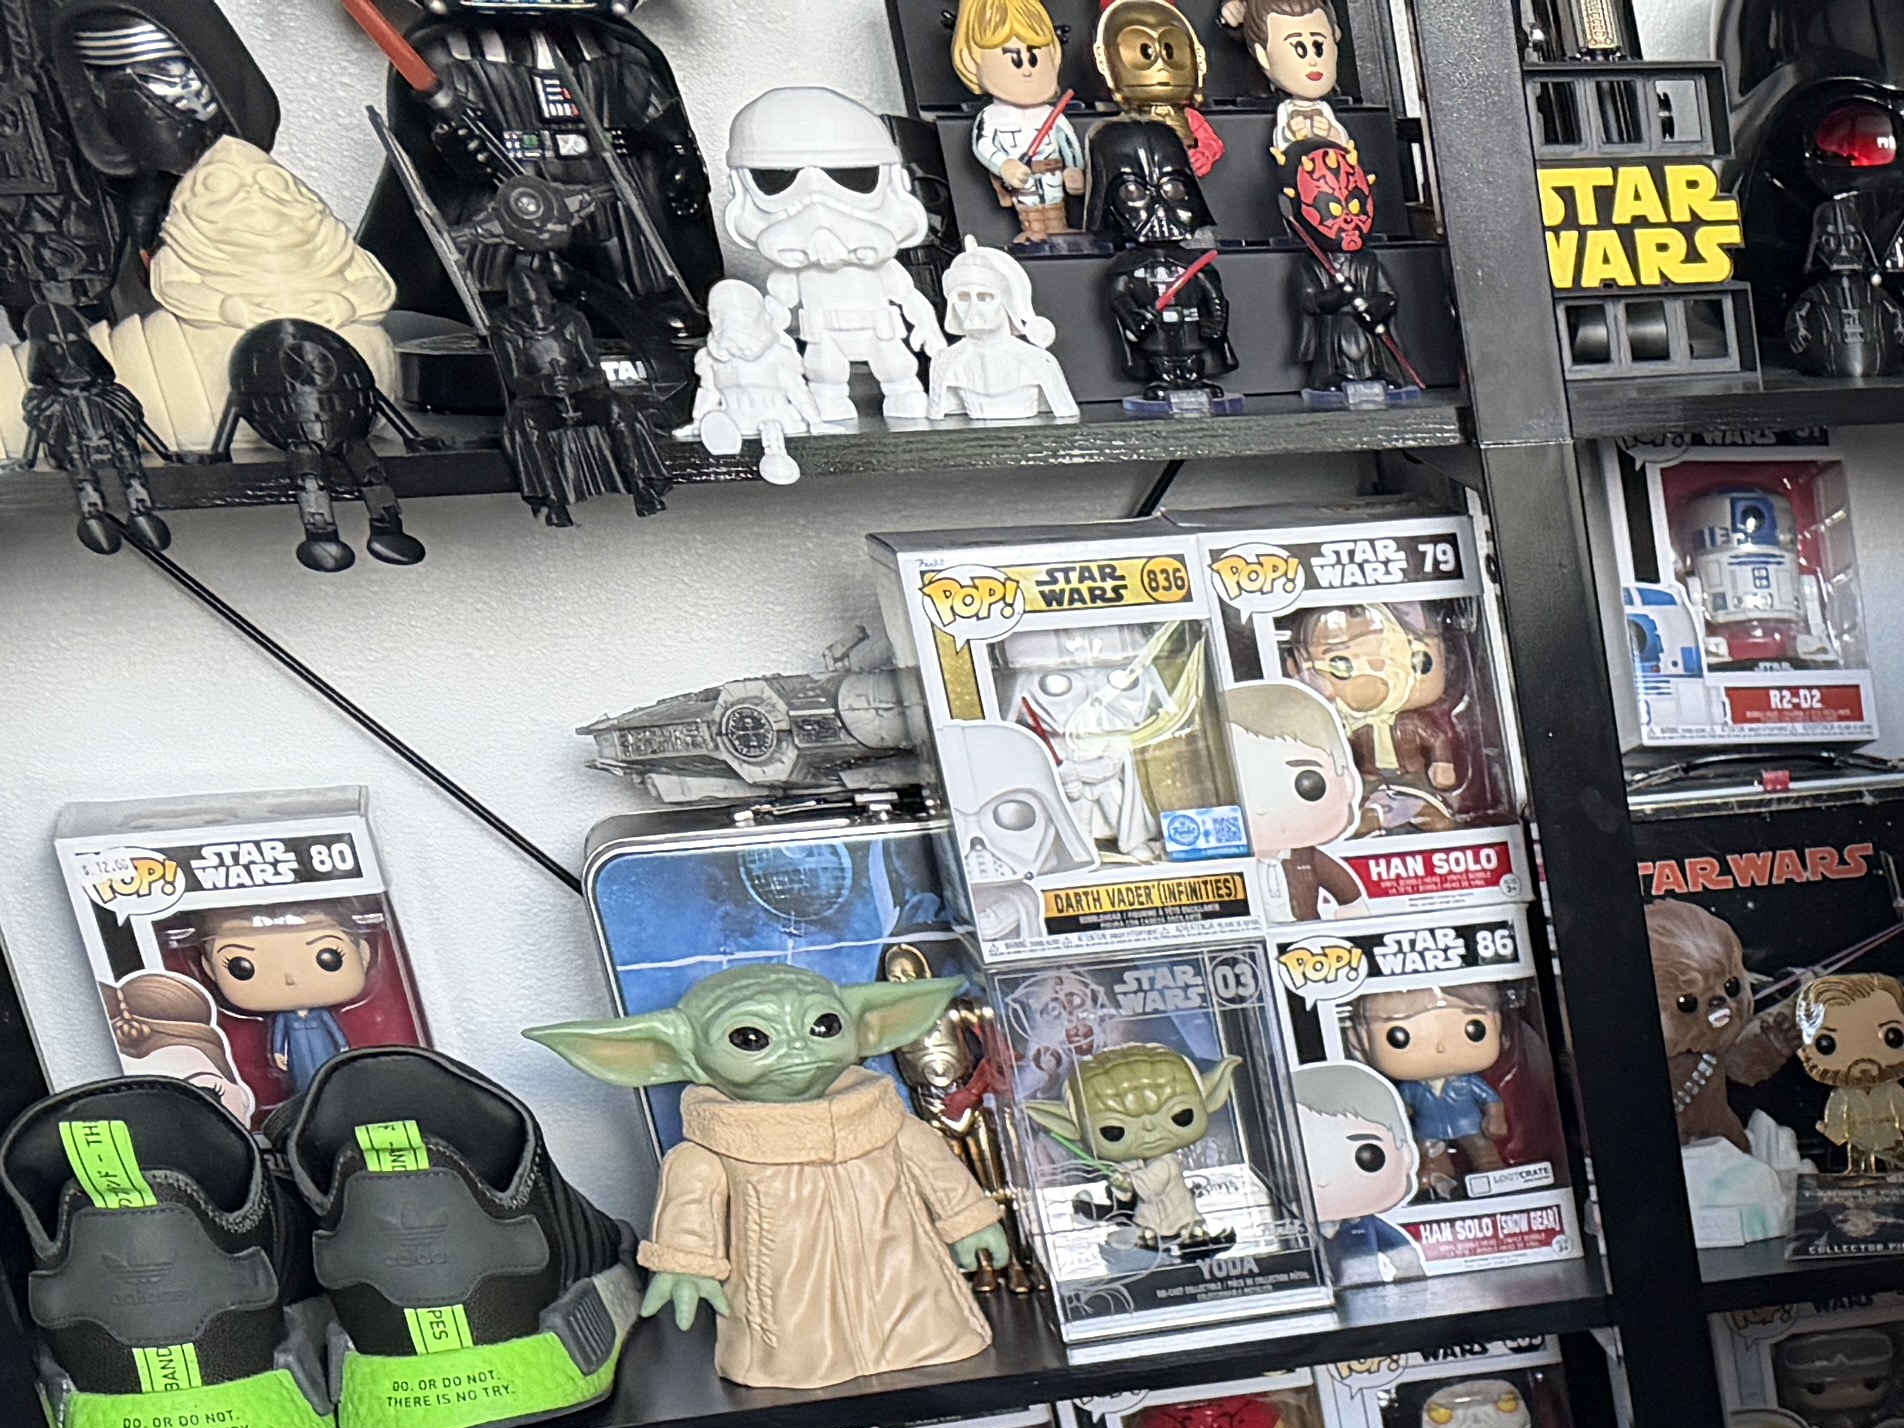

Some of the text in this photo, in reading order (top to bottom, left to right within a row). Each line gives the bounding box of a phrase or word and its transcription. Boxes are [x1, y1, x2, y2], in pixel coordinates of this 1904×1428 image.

[1310, 539, 1407, 567] STAR
[1418, 543, 1456, 573] 79
[1035, 564, 1127, 587] STAR
[1146, 567, 1186, 593] 836
[1210, 555, 1300, 600] POP!
[1312, 561, 1408, 588] WARS
[919, 576, 1020, 627] POP!
[1038, 583, 1128, 608] WARS
[1768, 689, 1823, 710] R2-D2
[190, 840, 297, 869] STAR
[309, 842, 355, 873] 80
[1369, 848, 1498, 881] HAN SOLO
[191, 861, 299, 890] WARS
[1637, 842, 1875, 896] TAR WARS
[1053, 892, 1101, 914] DARTH
[1157, 875, 1239, 907] (INFINITIES)
[1373, 928, 1467, 955] STAR
[1476, 928, 1515, 958] 86
[1279, 945, 1363, 990] POP!
[1375, 949, 1466, 976] WARS
[1113, 965, 1204, 993] STAR
[1214, 965, 1258, 999] 03
[1115, 986, 1208, 1016] WARS
[1419, 1222, 1453, 1245] HAN
[1455, 1217, 1493, 1240] SOLO
[1196, 1256, 1260, 1280] YODA
[392, 1380, 415, 1392] DO.
[418, 1379, 438, 1391] OR
[442, 1376, 462, 1388] DO
[386, 1395, 432, 1408] THERE
[436, 1393, 451, 1405] IS
[456, 1390, 478, 1402] NO
[152, 1416, 173, 1428] OR
[178, 1414, 200, 1427] DO
[205, 1409, 240, 1424] NOT.
